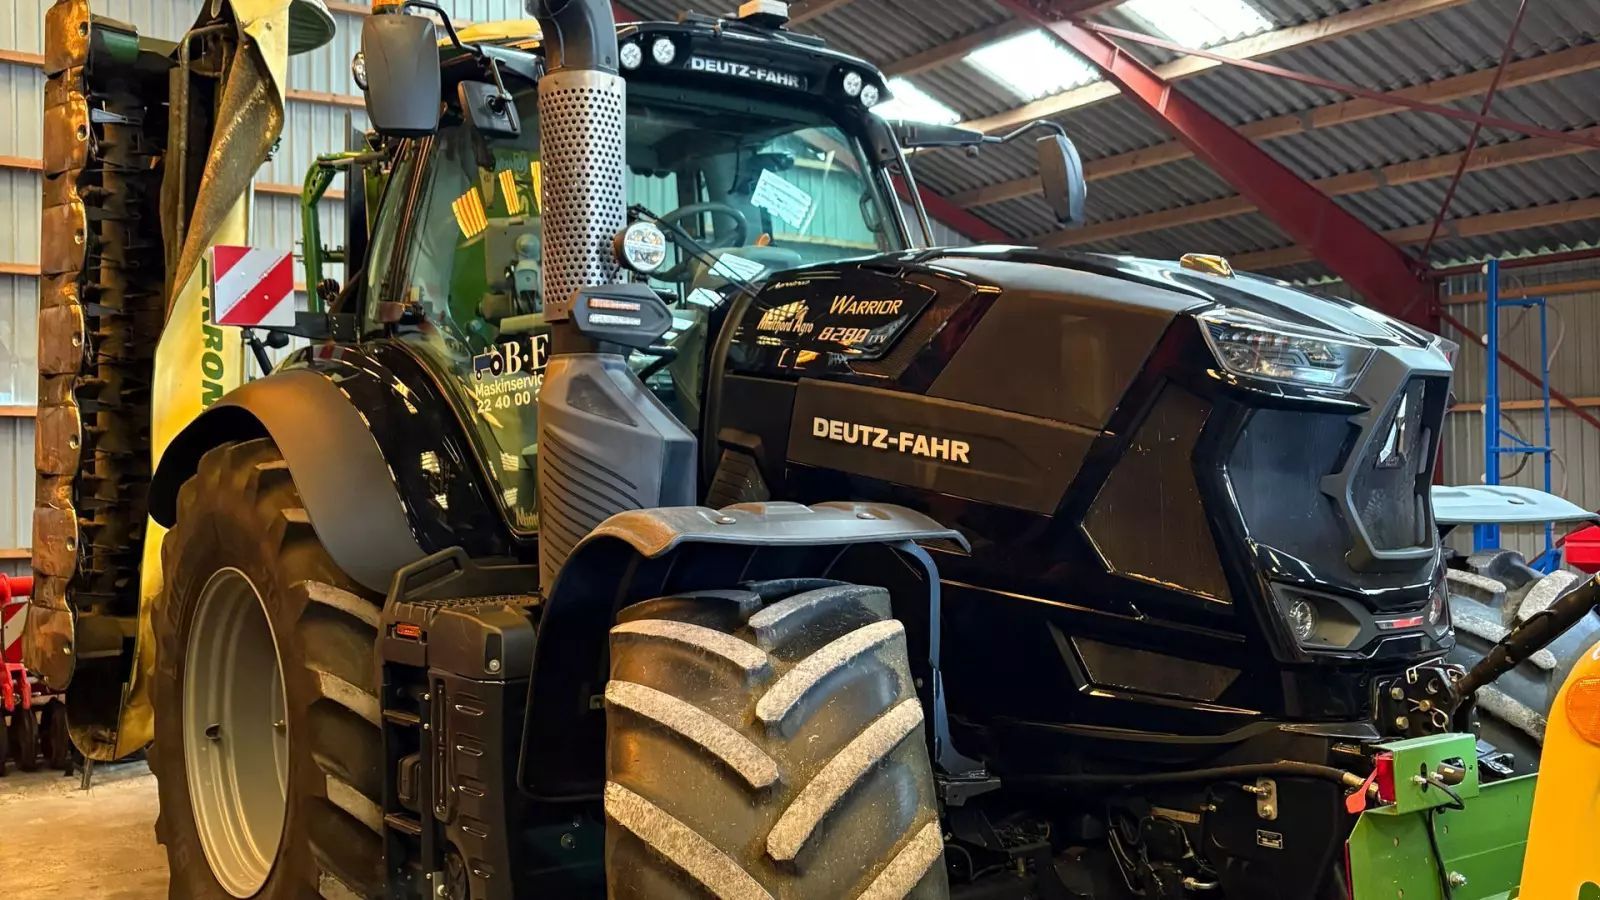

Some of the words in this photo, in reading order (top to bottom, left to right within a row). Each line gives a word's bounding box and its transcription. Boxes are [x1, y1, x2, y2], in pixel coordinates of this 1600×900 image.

[690, 56, 800, 88] DEUTZ-FAHR
[818, 326, 871, 342] 8280
[202, 297, 225, 411] RON
[477, 398, 492, 414] 22
[495, 394, 511, 410] 40
[514, 391, 531, 406] 00
[812, 416, 971, 464] DEUTZ-FAHR
